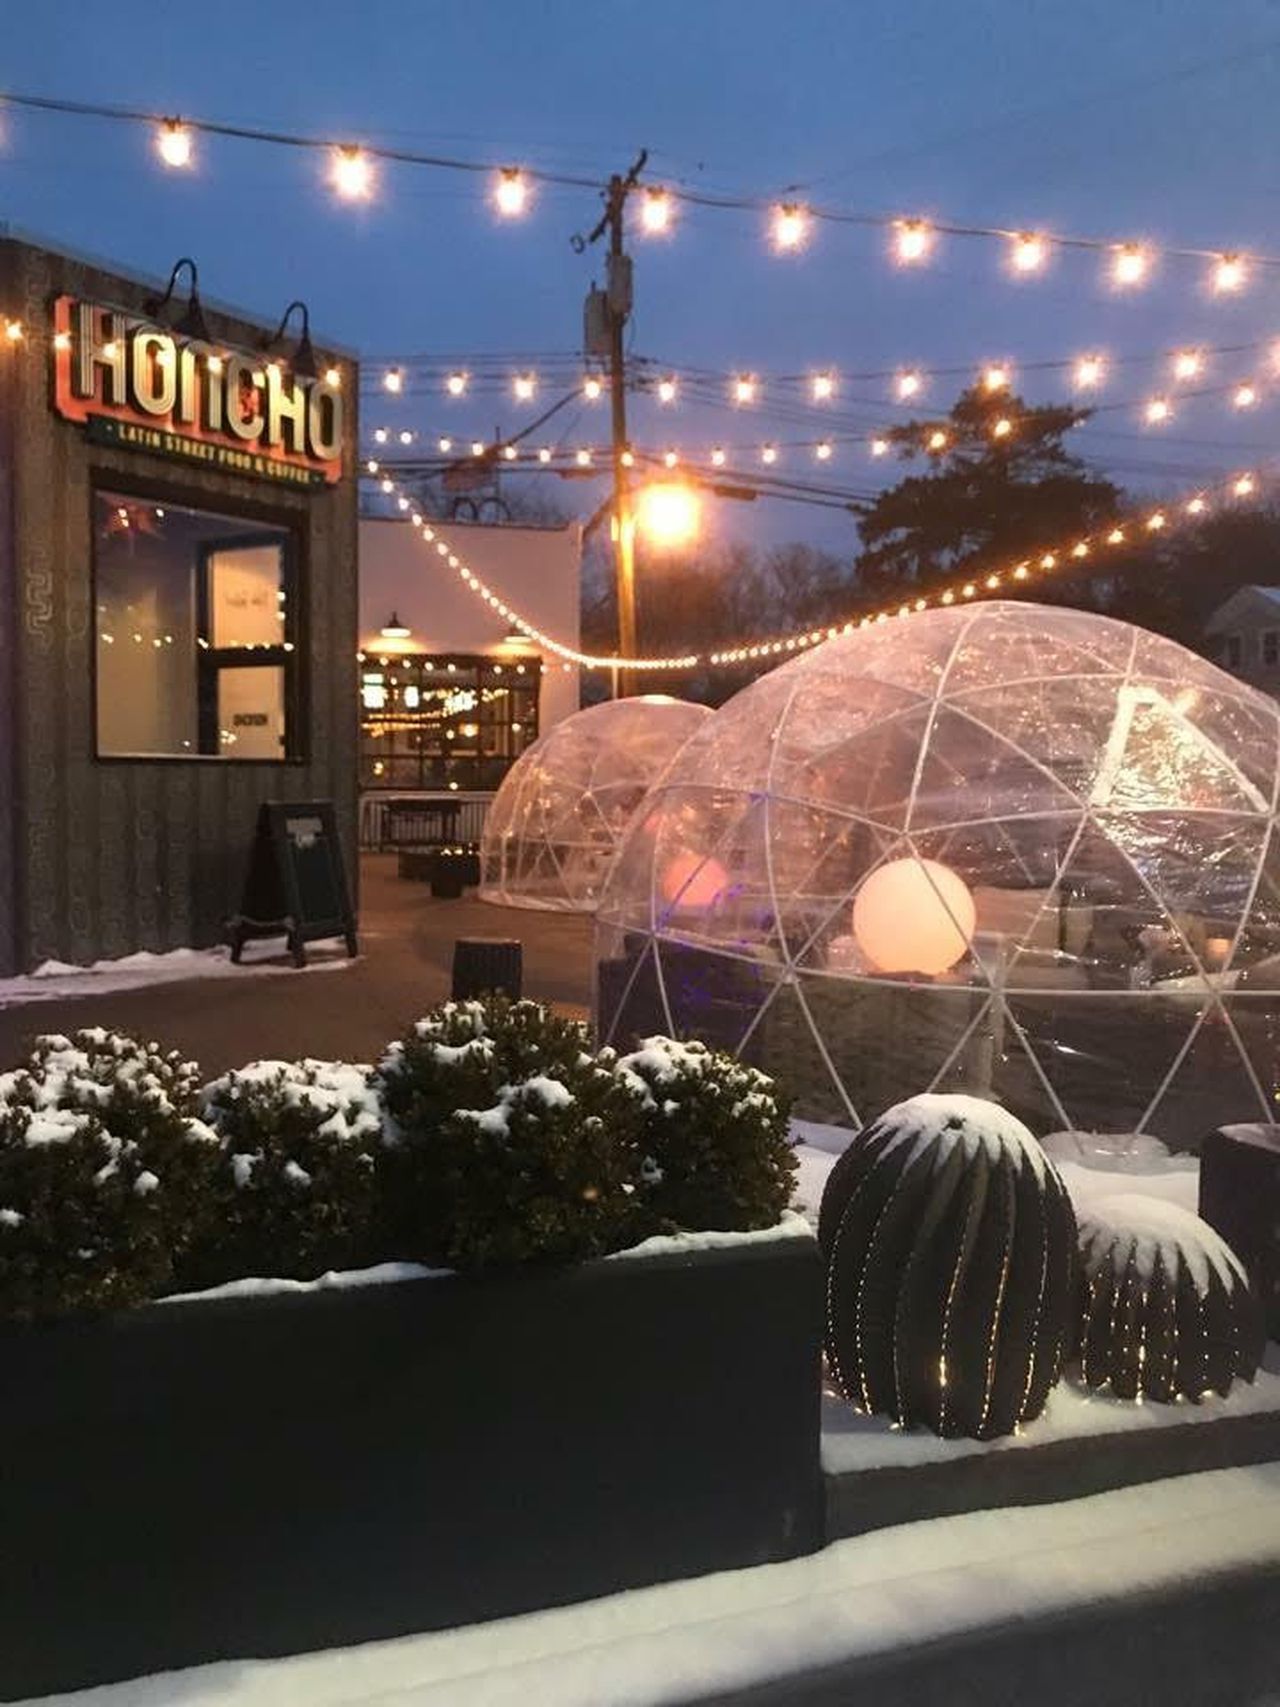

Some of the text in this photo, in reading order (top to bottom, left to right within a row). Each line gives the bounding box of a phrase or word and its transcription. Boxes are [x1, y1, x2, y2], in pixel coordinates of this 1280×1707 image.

[119, 424, 310, 484] LATIN STREET FOOD & COFFEE
